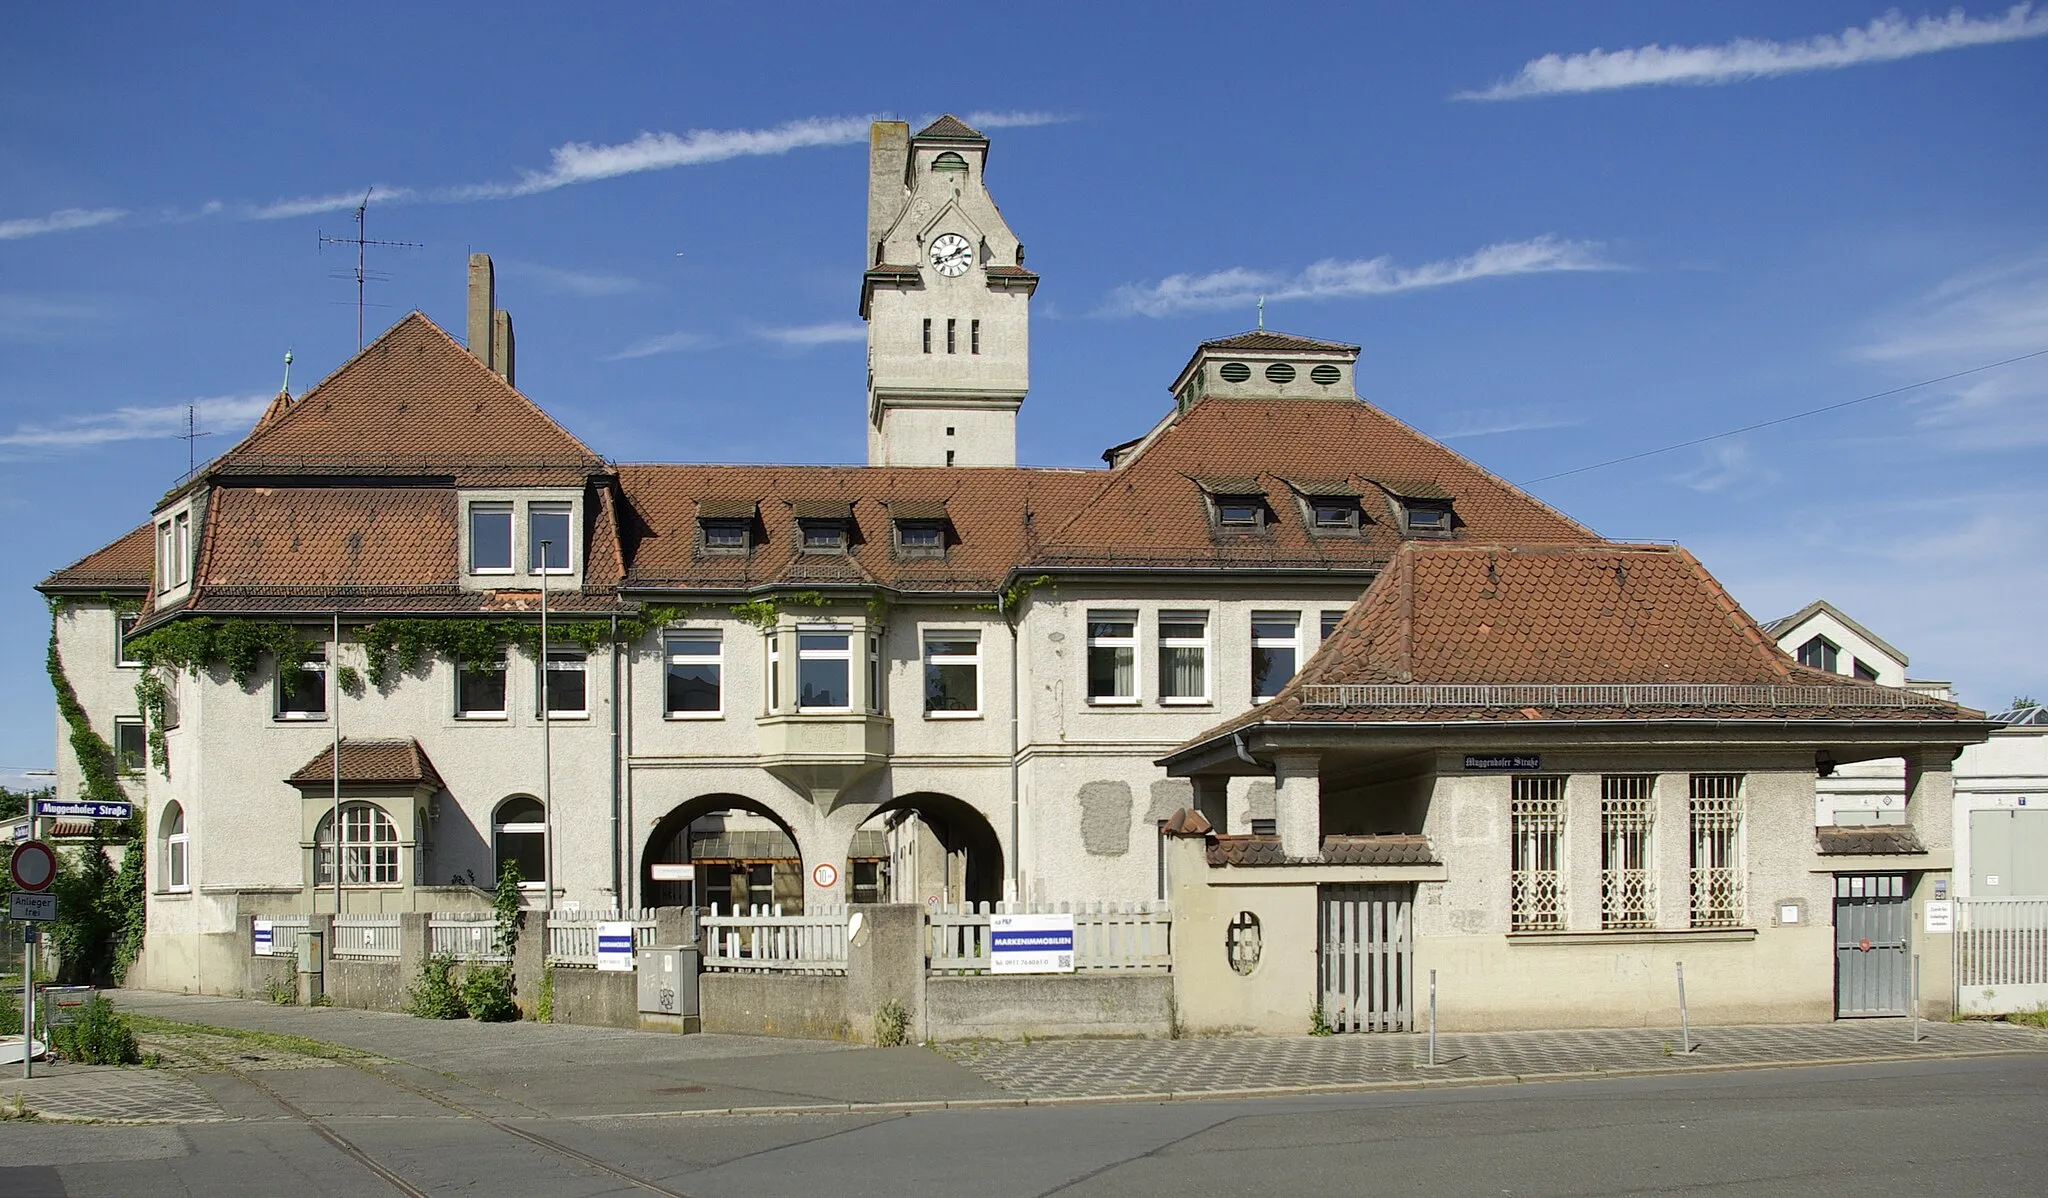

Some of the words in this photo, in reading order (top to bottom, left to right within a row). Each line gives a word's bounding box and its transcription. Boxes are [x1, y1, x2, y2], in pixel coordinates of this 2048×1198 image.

[1465, 757, 1511, 768] Muggenhofer
[42, 803, 96, 815] Muggenhofer
[99, 805, 127, 817] Straße
[15, 897, 52, 909] Anlieger
[25, 908, 41, 917] frei
[994, 937, 1071, 946] MARKENIMMOBILIEN
